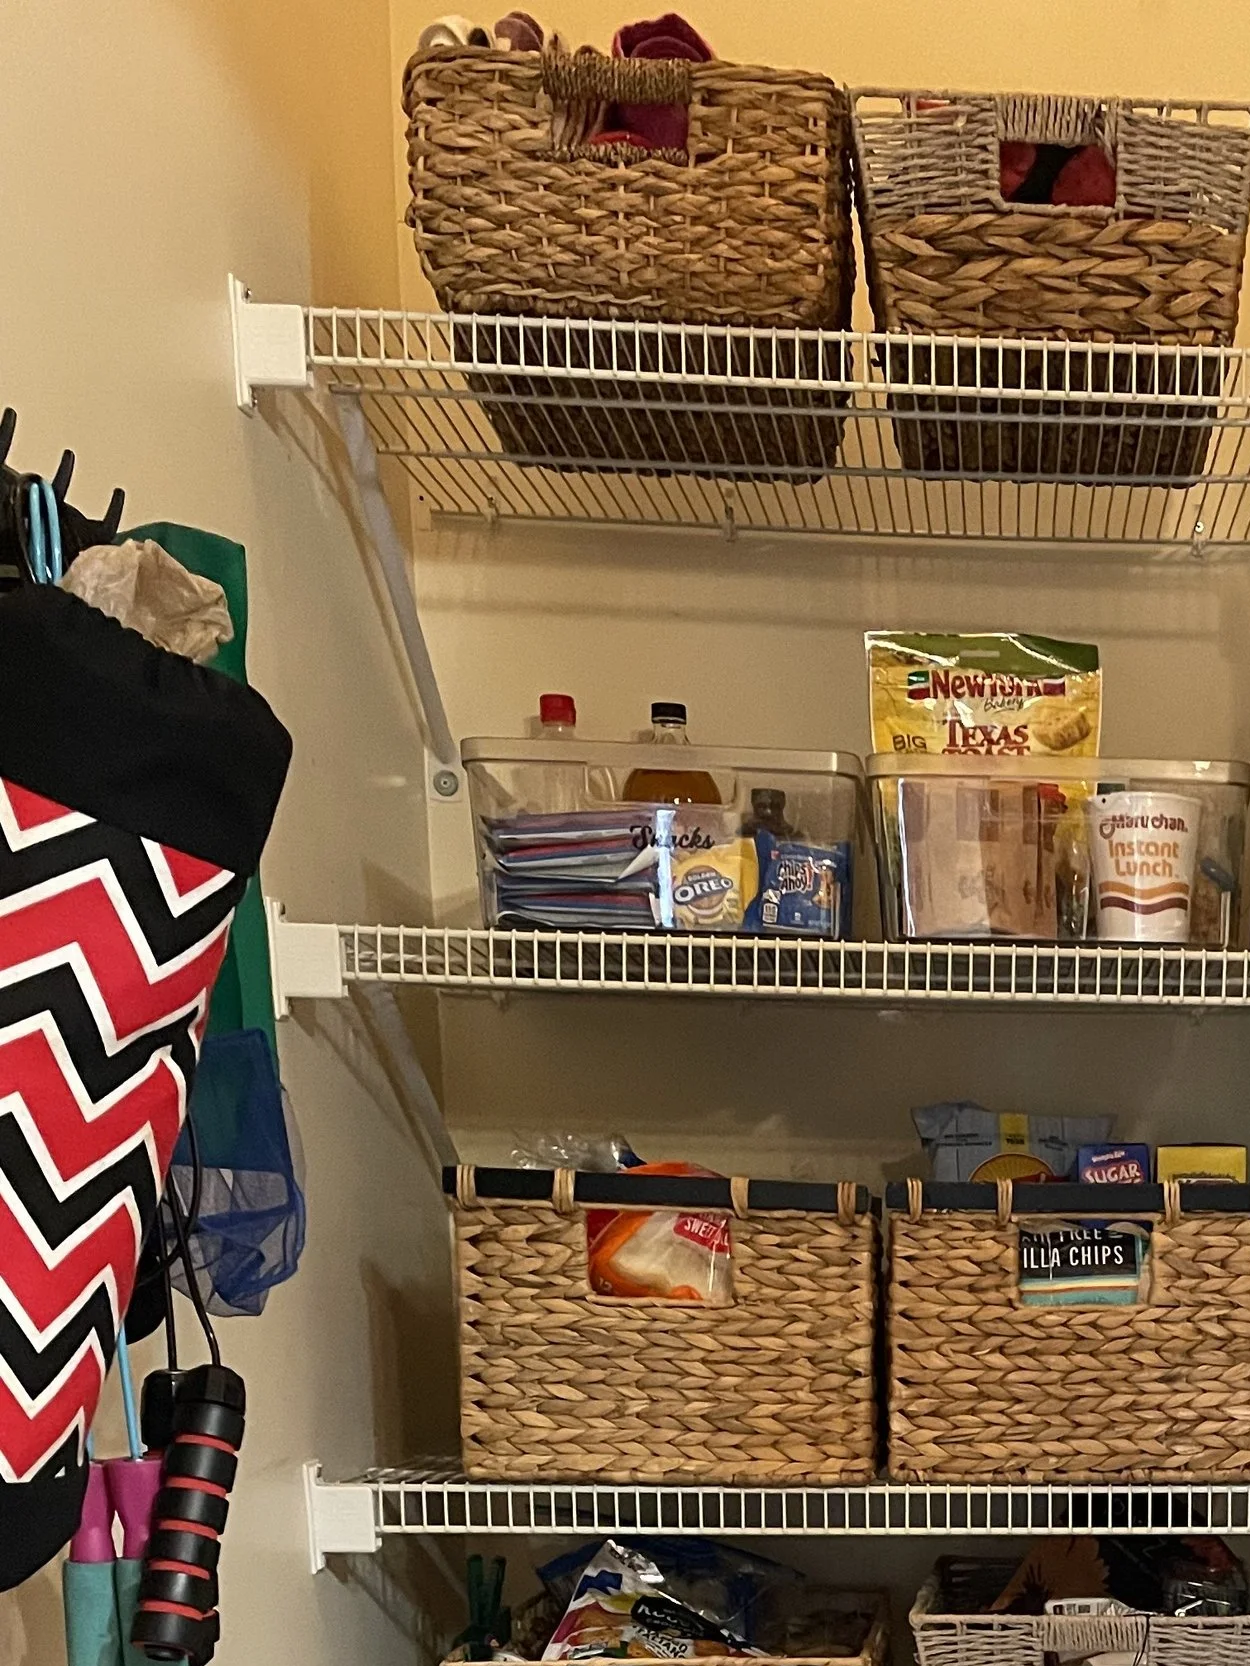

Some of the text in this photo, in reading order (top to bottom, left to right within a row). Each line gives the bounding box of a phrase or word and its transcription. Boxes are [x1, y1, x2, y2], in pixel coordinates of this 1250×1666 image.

[891, 734, 928, 751] BIG
[946, 718, 1030, 748] TEXAS
[1107, 839, 1180, 860] Instant
[674, 877, 733, 904] OREO
[1083, 1163, 1142, 1183] SUGAR
[1068, 1244, 1125, 1266] CHIPS
